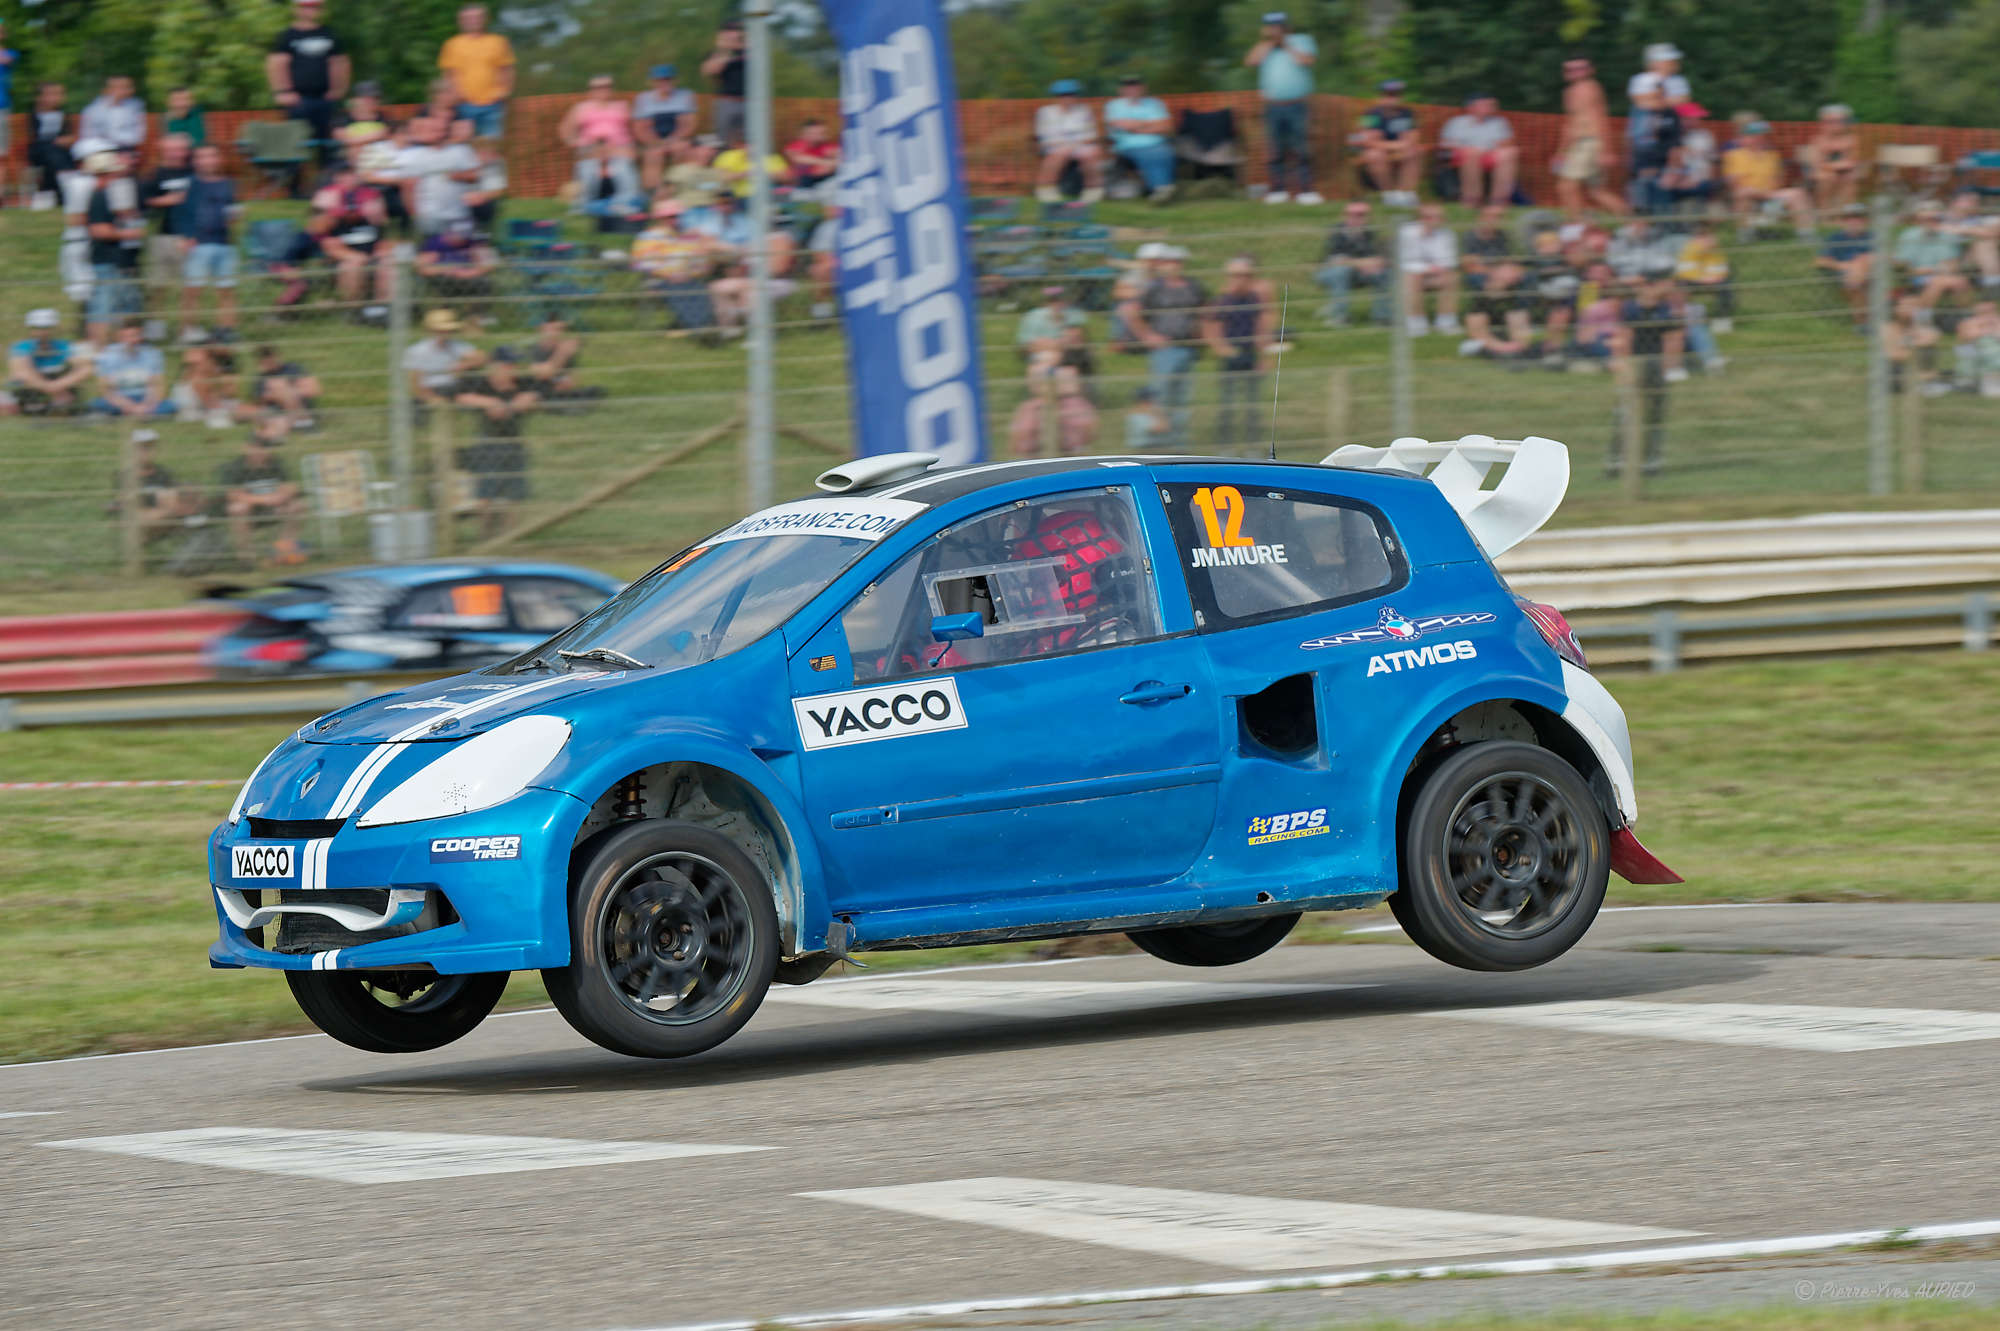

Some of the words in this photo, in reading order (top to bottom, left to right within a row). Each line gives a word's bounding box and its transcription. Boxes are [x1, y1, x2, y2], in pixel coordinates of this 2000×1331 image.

[1193, 486, 1254, 547] 12
[1192, 544, 1288, 567] JM.MURE
[1367, 640, 1477, 677] ATMOS
[807, 690, 951, 737] YACCO
[1270, 809, 1326, 833] BPS
[431, 836, 521, 853] COOPER
[473, 849, 518, 860] TIRES
[235, 847, 289, 877] YACCO
